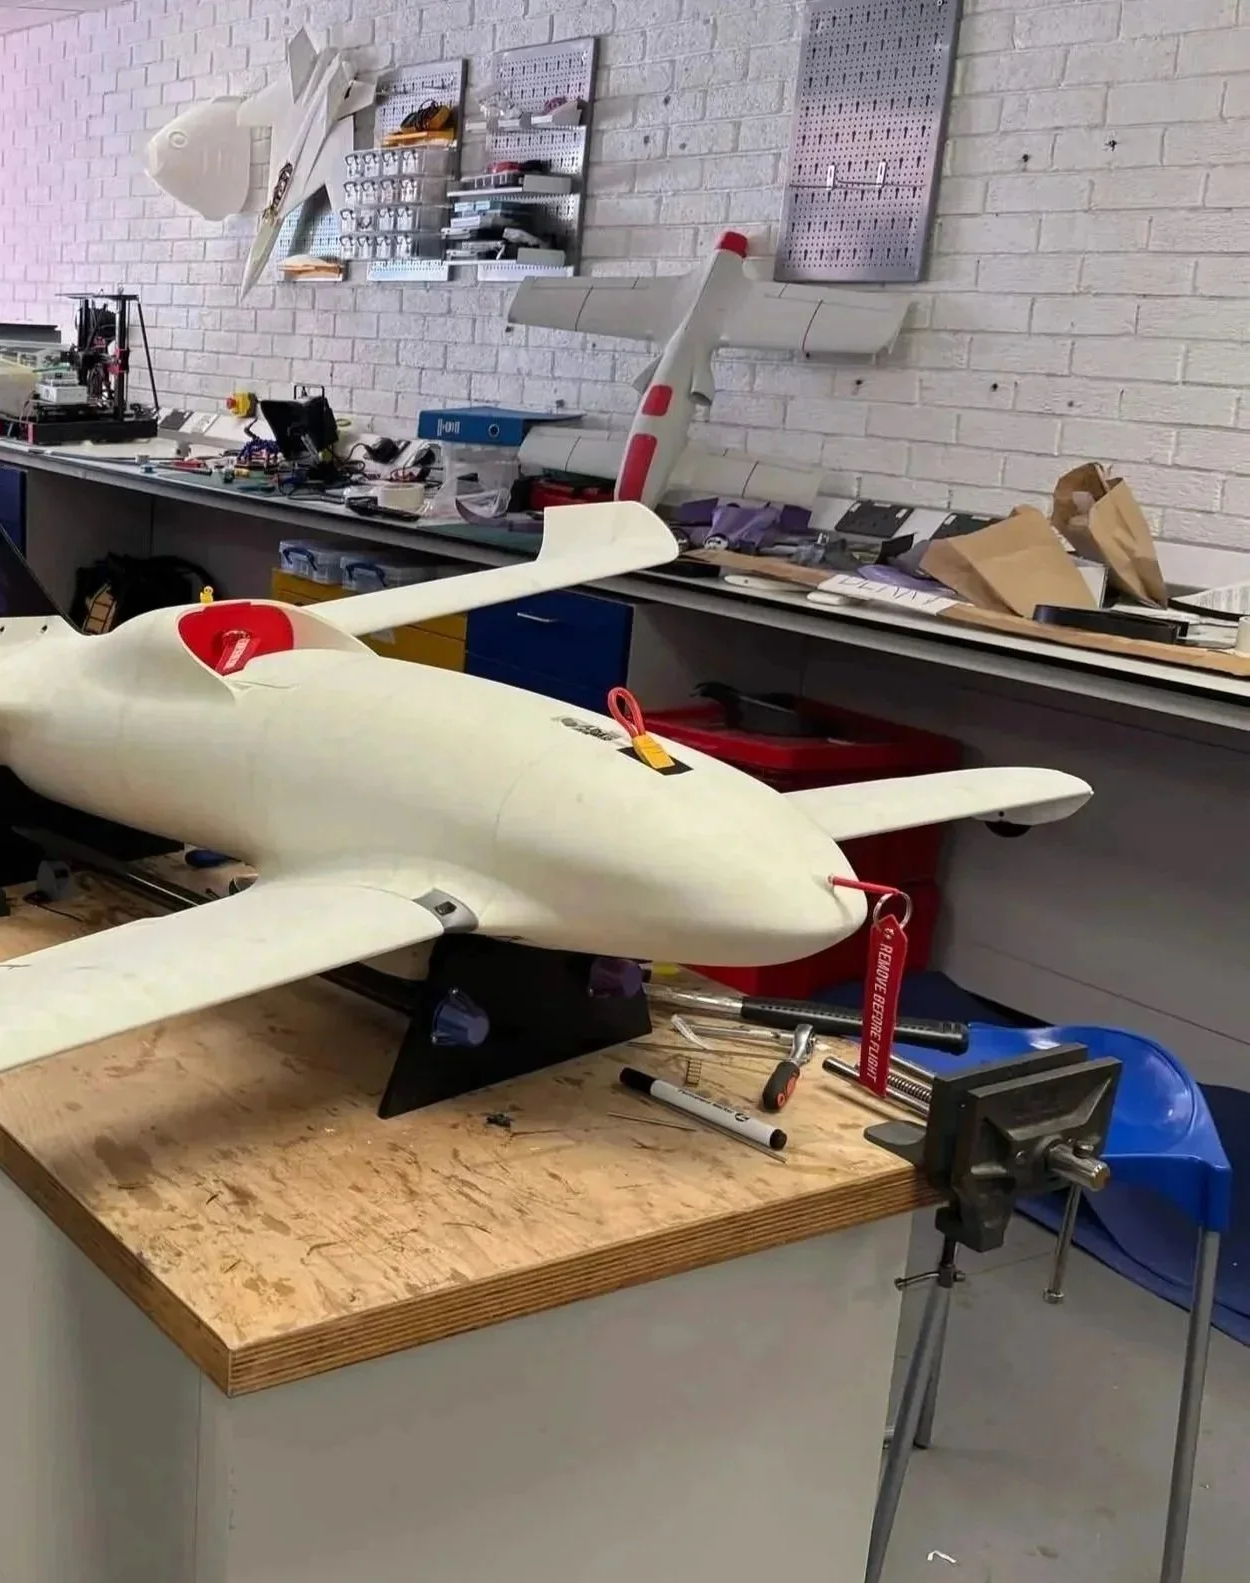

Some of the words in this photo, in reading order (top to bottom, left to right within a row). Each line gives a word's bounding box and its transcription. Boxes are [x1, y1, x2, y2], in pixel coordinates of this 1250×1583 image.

[874, 943, 893, 994] REMOVE
[869, 993, 886, 1041] BEFORE
[867, 1040, 881, 1083] FLIGHT
